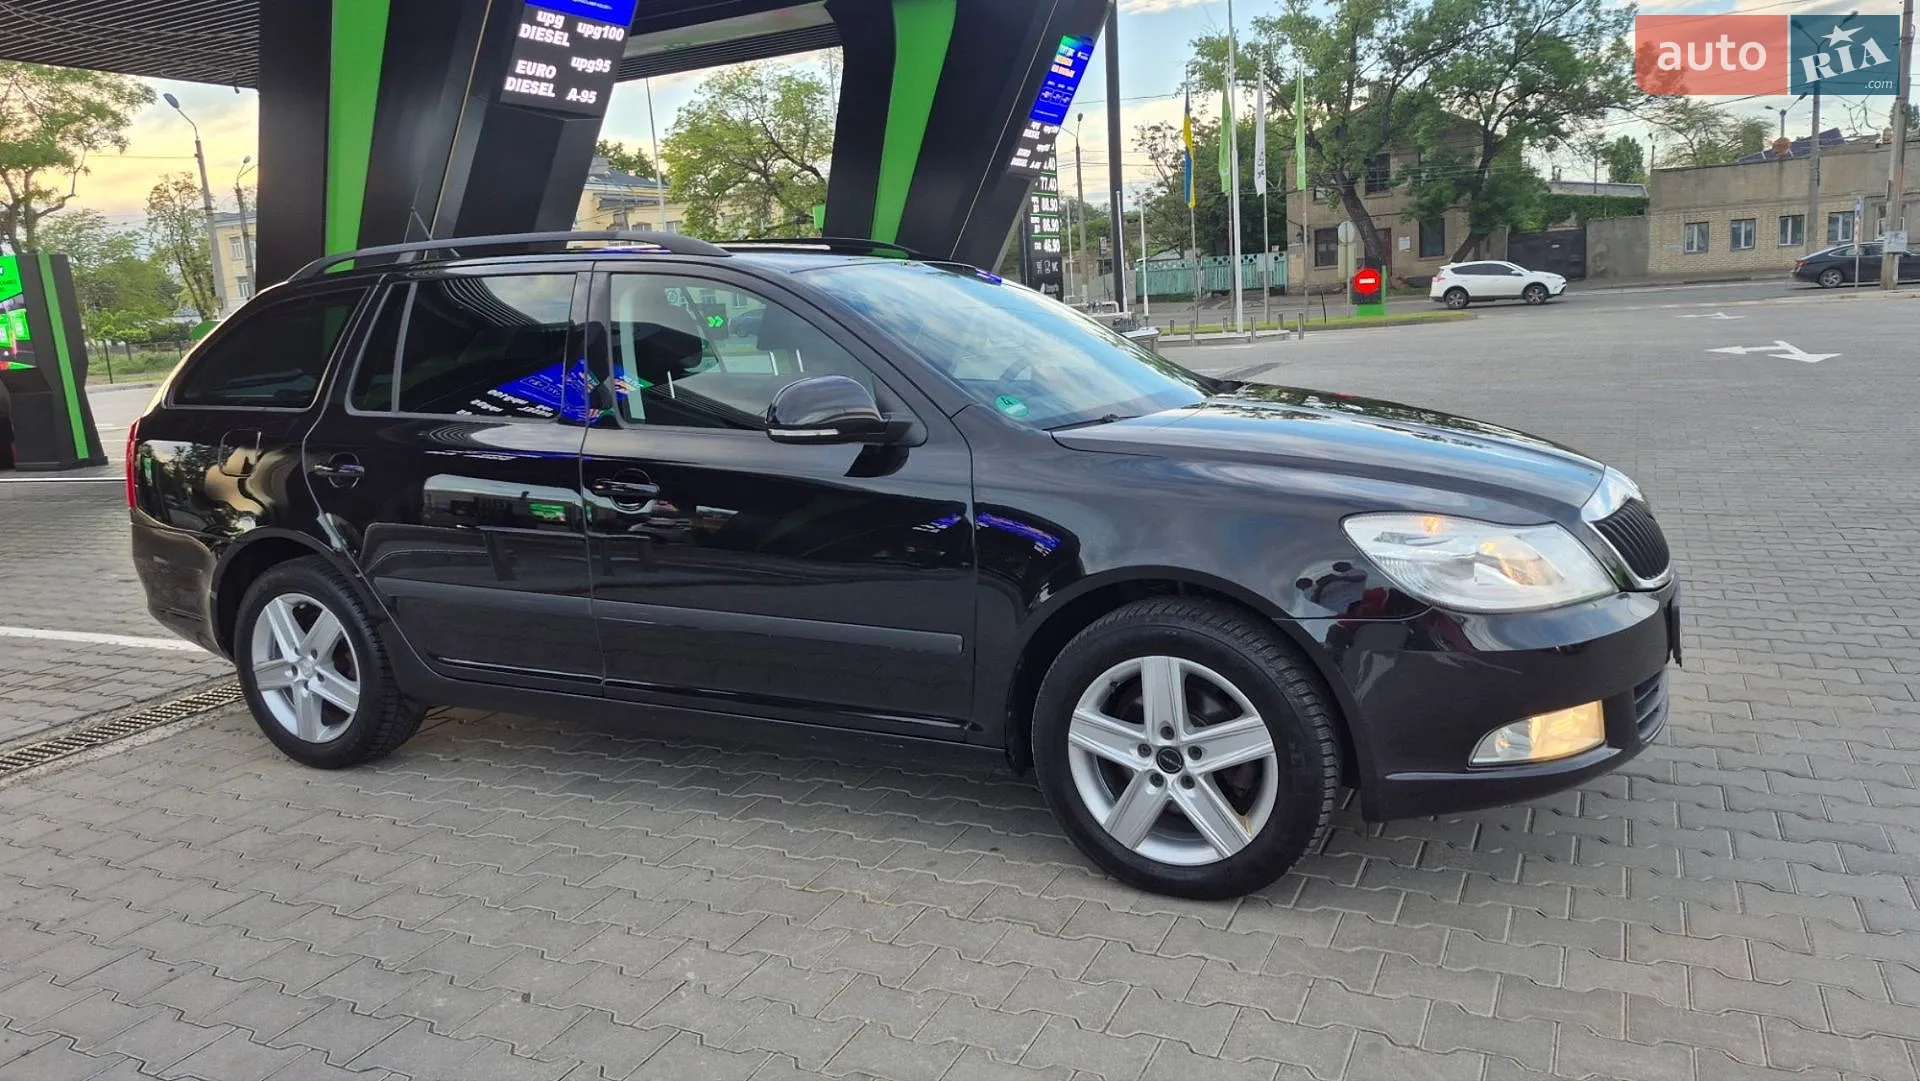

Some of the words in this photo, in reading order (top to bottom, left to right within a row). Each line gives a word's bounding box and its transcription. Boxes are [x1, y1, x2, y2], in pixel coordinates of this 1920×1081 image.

[536, 11, 565, 29] upg
[518, 23, 571, 47] DIESEL
[576, 22, 625, 42] upg100
[515, 59, 557, 79] EURO
[570, 56, 612, 73] upg95
[504, 77, 556, 97] DIESEL
[565, 88, 598, 104] A-95
